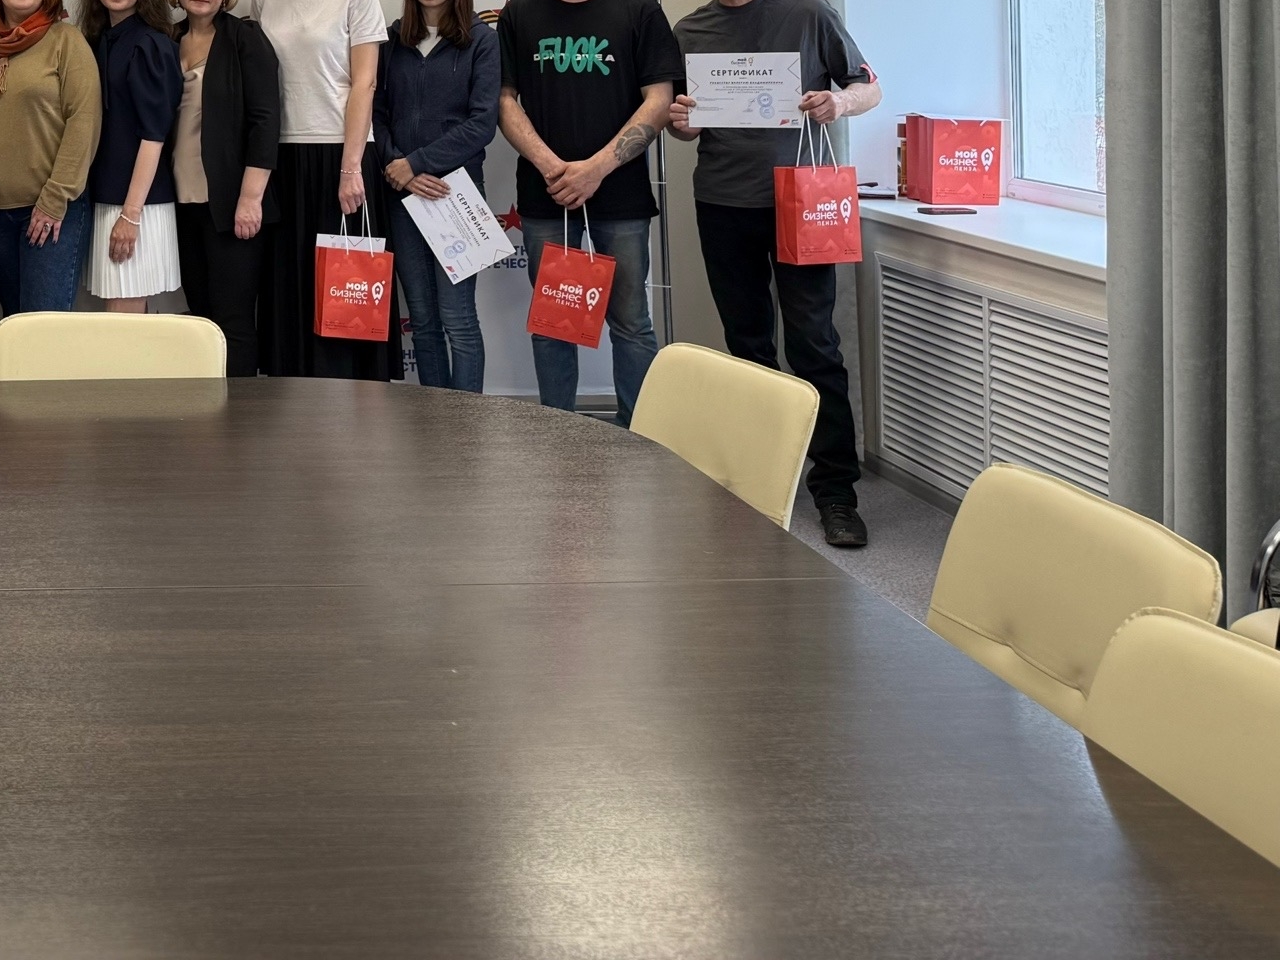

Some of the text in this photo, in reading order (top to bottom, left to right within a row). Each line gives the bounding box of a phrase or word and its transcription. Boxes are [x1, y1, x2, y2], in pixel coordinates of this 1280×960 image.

[538, 35, 610, 76] FUCK
[604, 54, 616, 62] A
[710, 69, 773, 77] СЕРТИФИКАТ
[939, 155, 978, 166] бизнес
[456, 192, 490, 241] СЕРТИФИКАТ
[802, 210, 838, 221] бизнес
[329, 286, 368, 300] бизнес
[541, 284, 582, 303] бизнес
